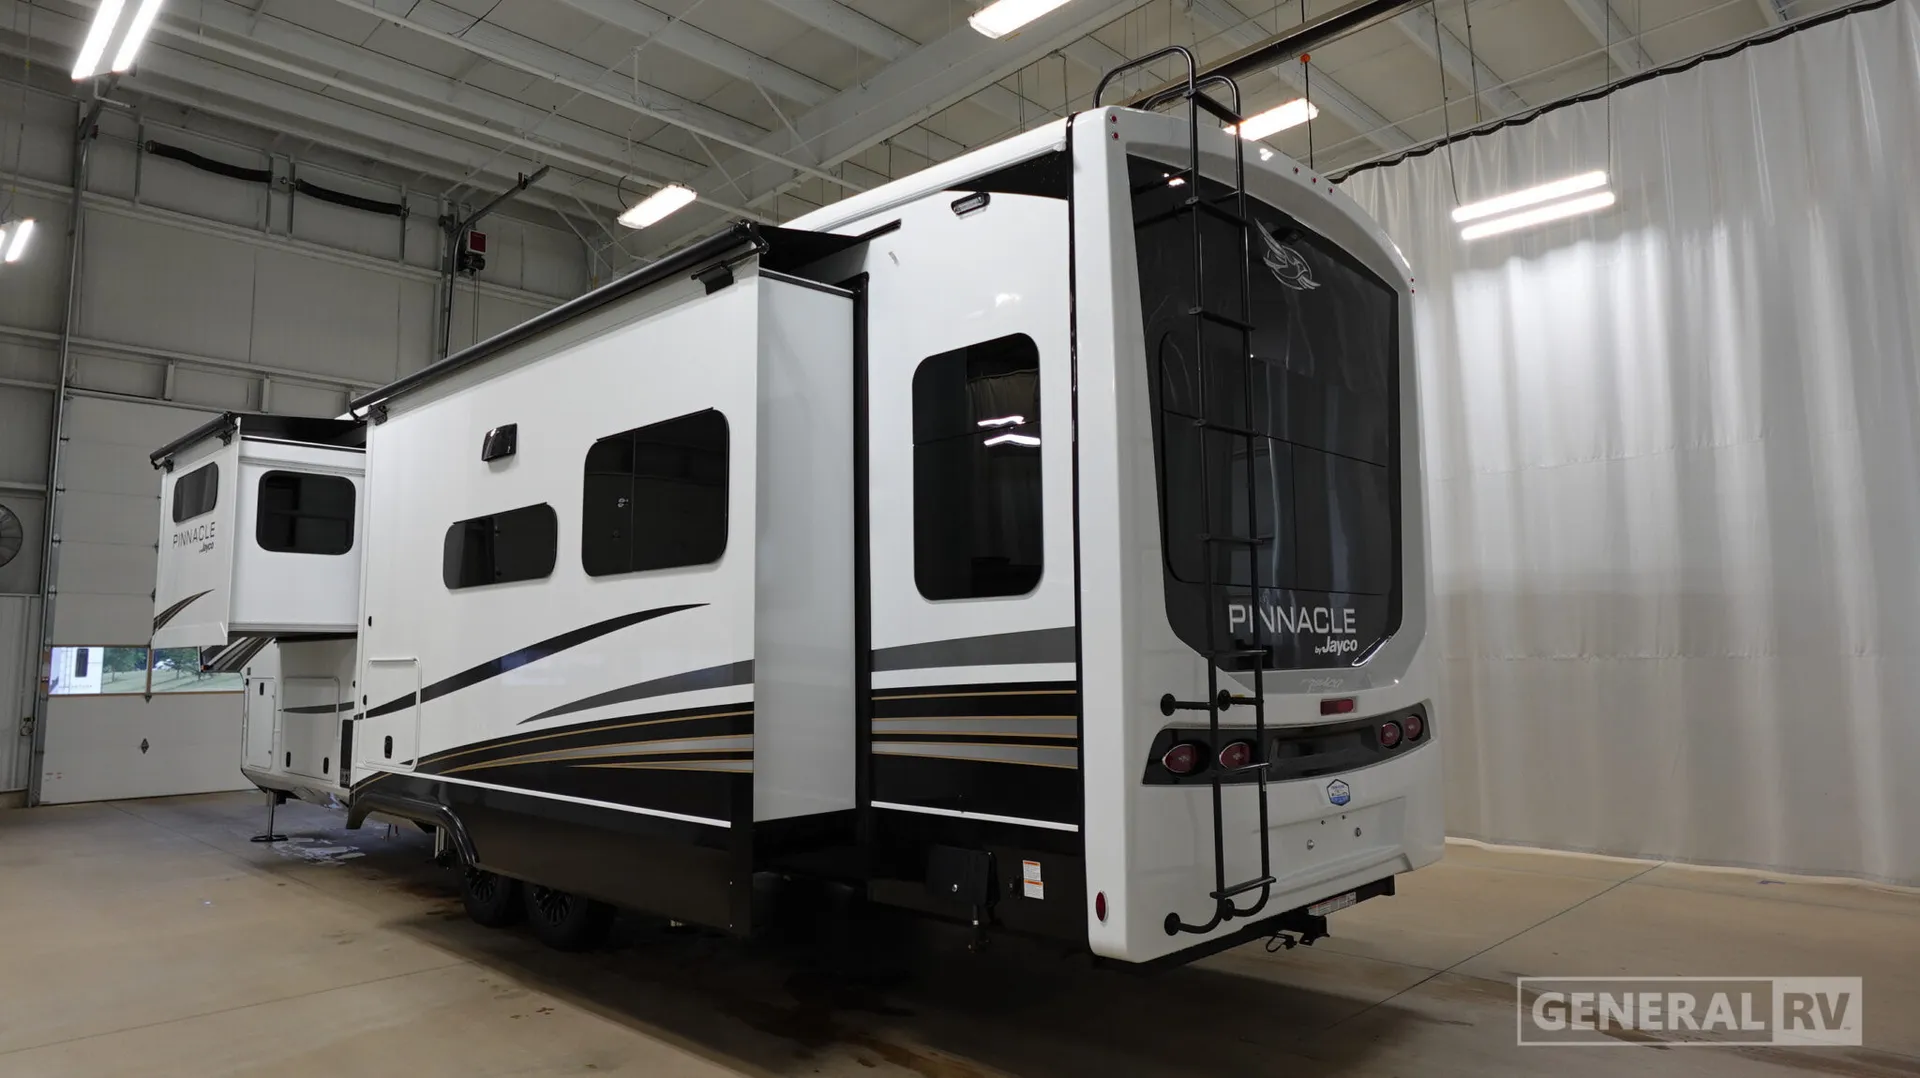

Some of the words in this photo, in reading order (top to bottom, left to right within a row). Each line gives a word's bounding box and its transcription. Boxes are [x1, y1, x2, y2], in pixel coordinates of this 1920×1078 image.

[172, 521, 216, 549] PINNACLE
[1228, 603, 1357, 634] PINNACLE
[1321, 635, 1359, 656] Jayco
